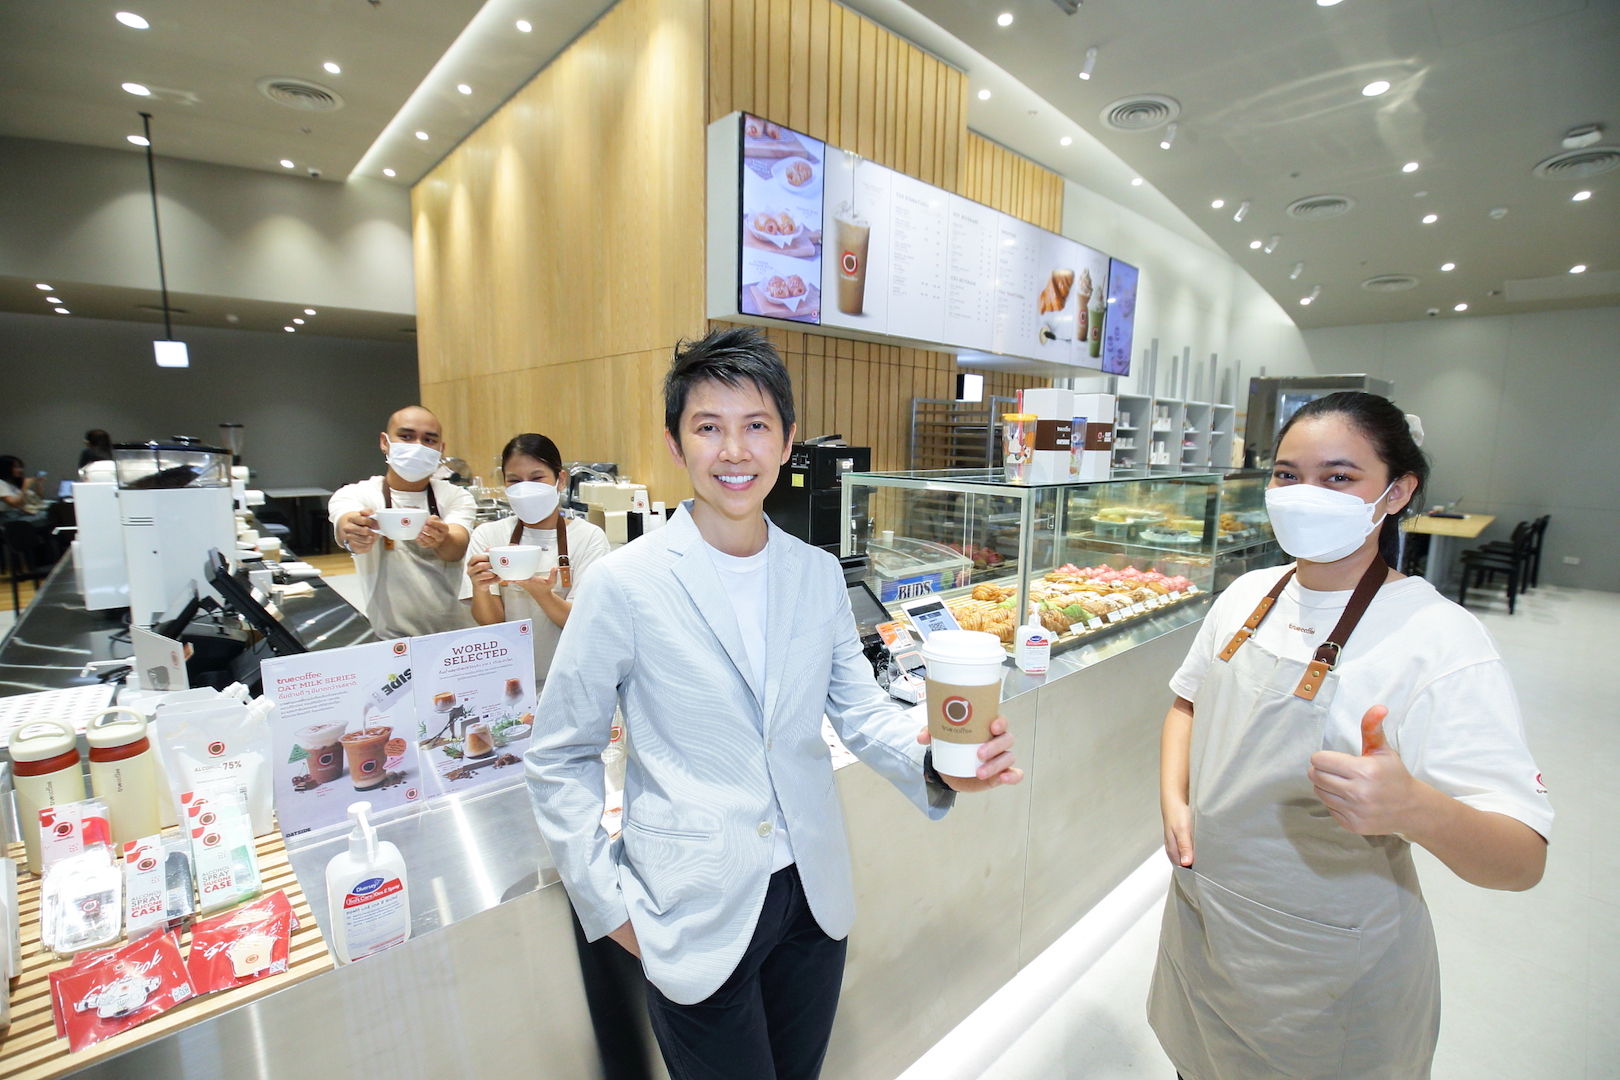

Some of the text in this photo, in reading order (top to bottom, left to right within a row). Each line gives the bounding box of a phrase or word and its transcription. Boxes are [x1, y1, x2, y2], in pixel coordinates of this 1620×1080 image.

[452, 641, 498, 655] WORLD
[444, 648, 508, 666] SELECTED
[276, 671, 323, 685] truecoffee
[277, 673, 357, 692] OAT MILK SERIES
[222, 760, 242, 770] 75%
[201, 865, 230, 877] ALCOHOL
[202, 870, 230, 883] SPRAY
[203, 875, 231, 887] SILICONE
[203, 880, 232, 894] CASE
[356, 884, 377, 893] Diversey
[131, 890, 162, 901] ALCOHOL
[131, 895, 162, 908] SPRAY
[131, 900, 163, 912] SILICONE
[131, 905, 163, 918] CASE
